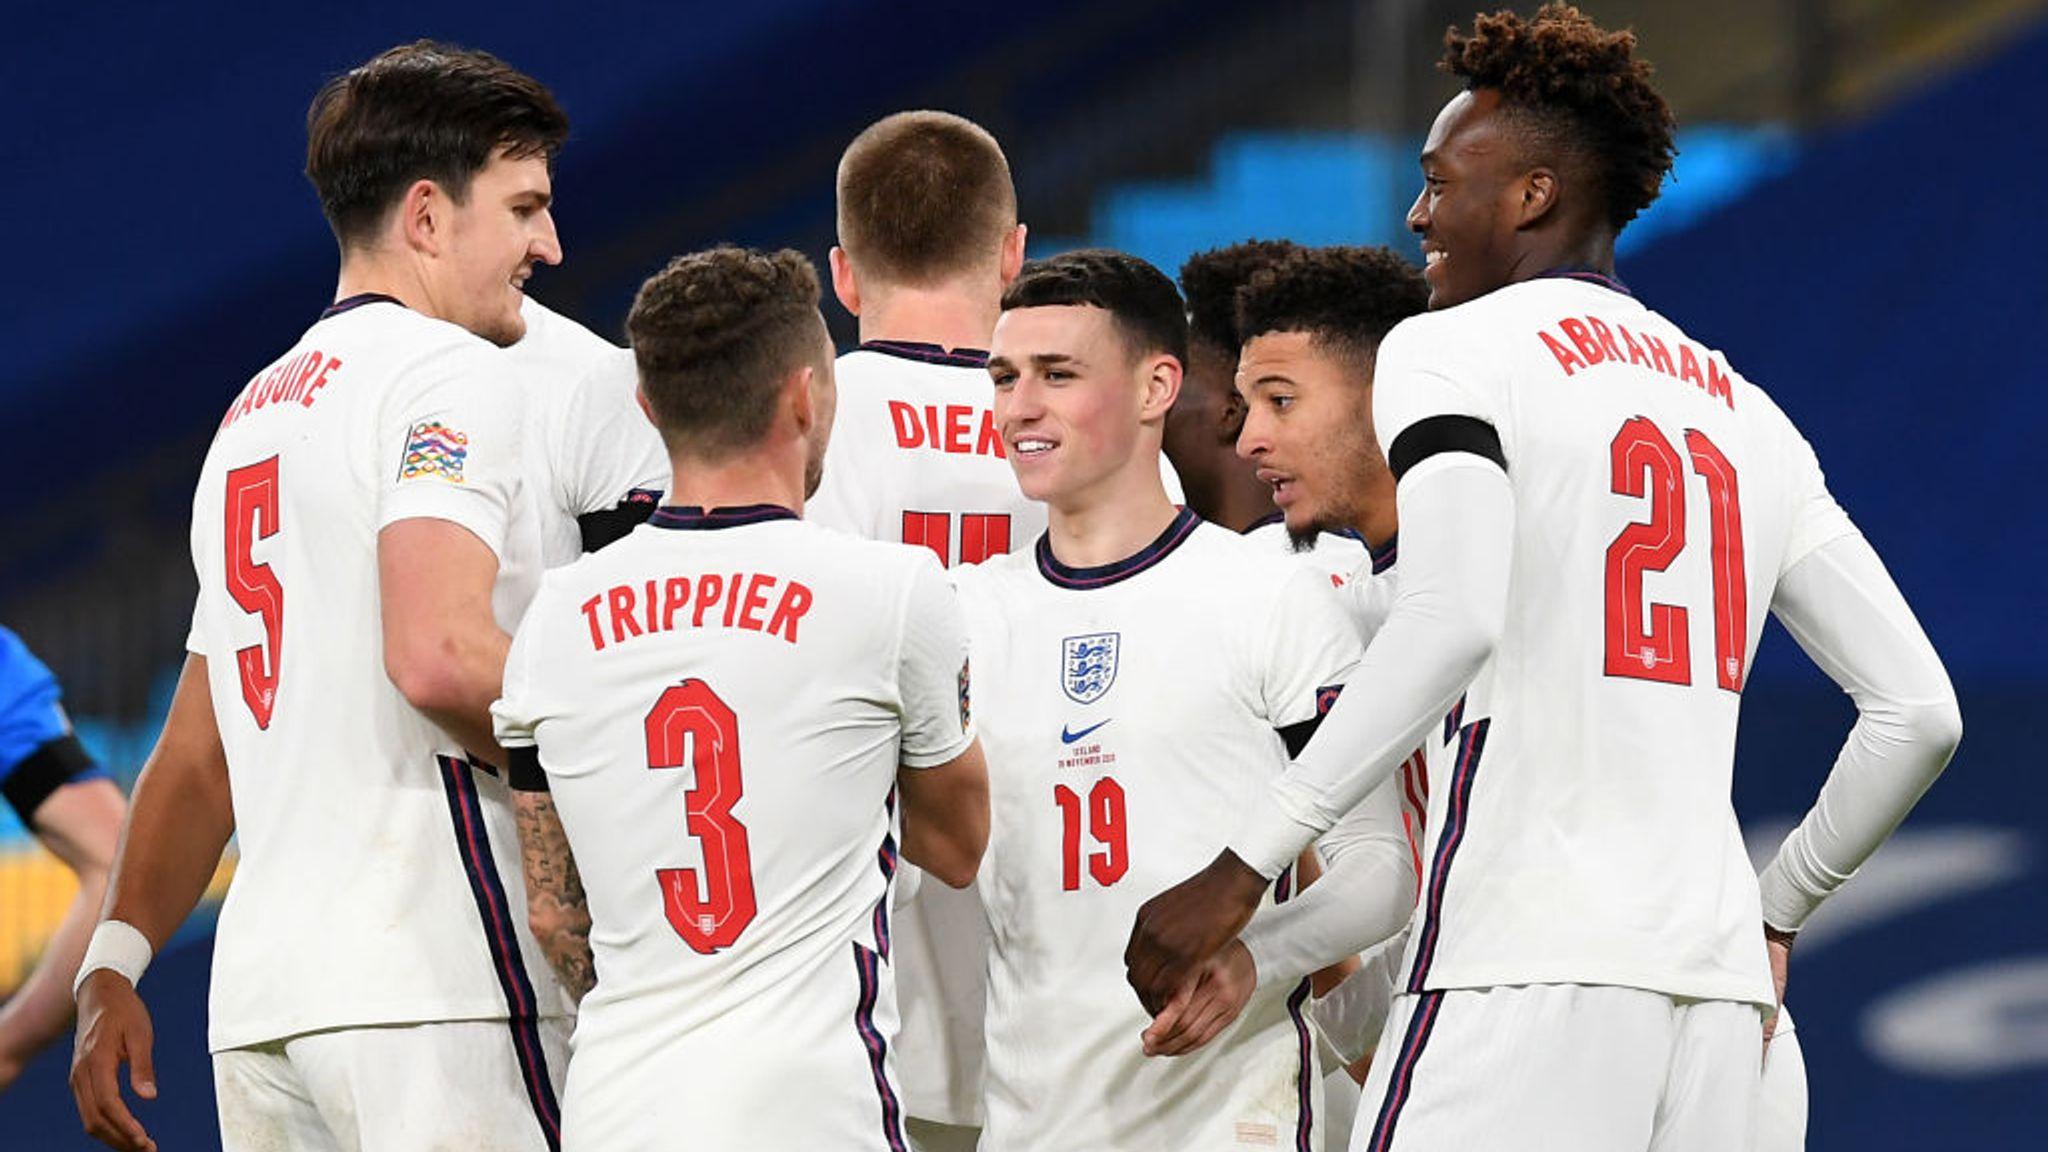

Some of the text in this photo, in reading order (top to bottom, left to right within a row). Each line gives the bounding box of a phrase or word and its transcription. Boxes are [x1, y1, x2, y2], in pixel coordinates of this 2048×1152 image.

[219, 350, 342, 430] MAGUIRE
[1537, 315, 1735, 411] ABRAHAM
[224, 453, 284, 731] 5
[1604, 414, 1746, 694] 21
[580, 572, 814, 652] TRIPPIER
[644, 677, 758, 955] 3
[1054, 776, 1130, 891] 19
